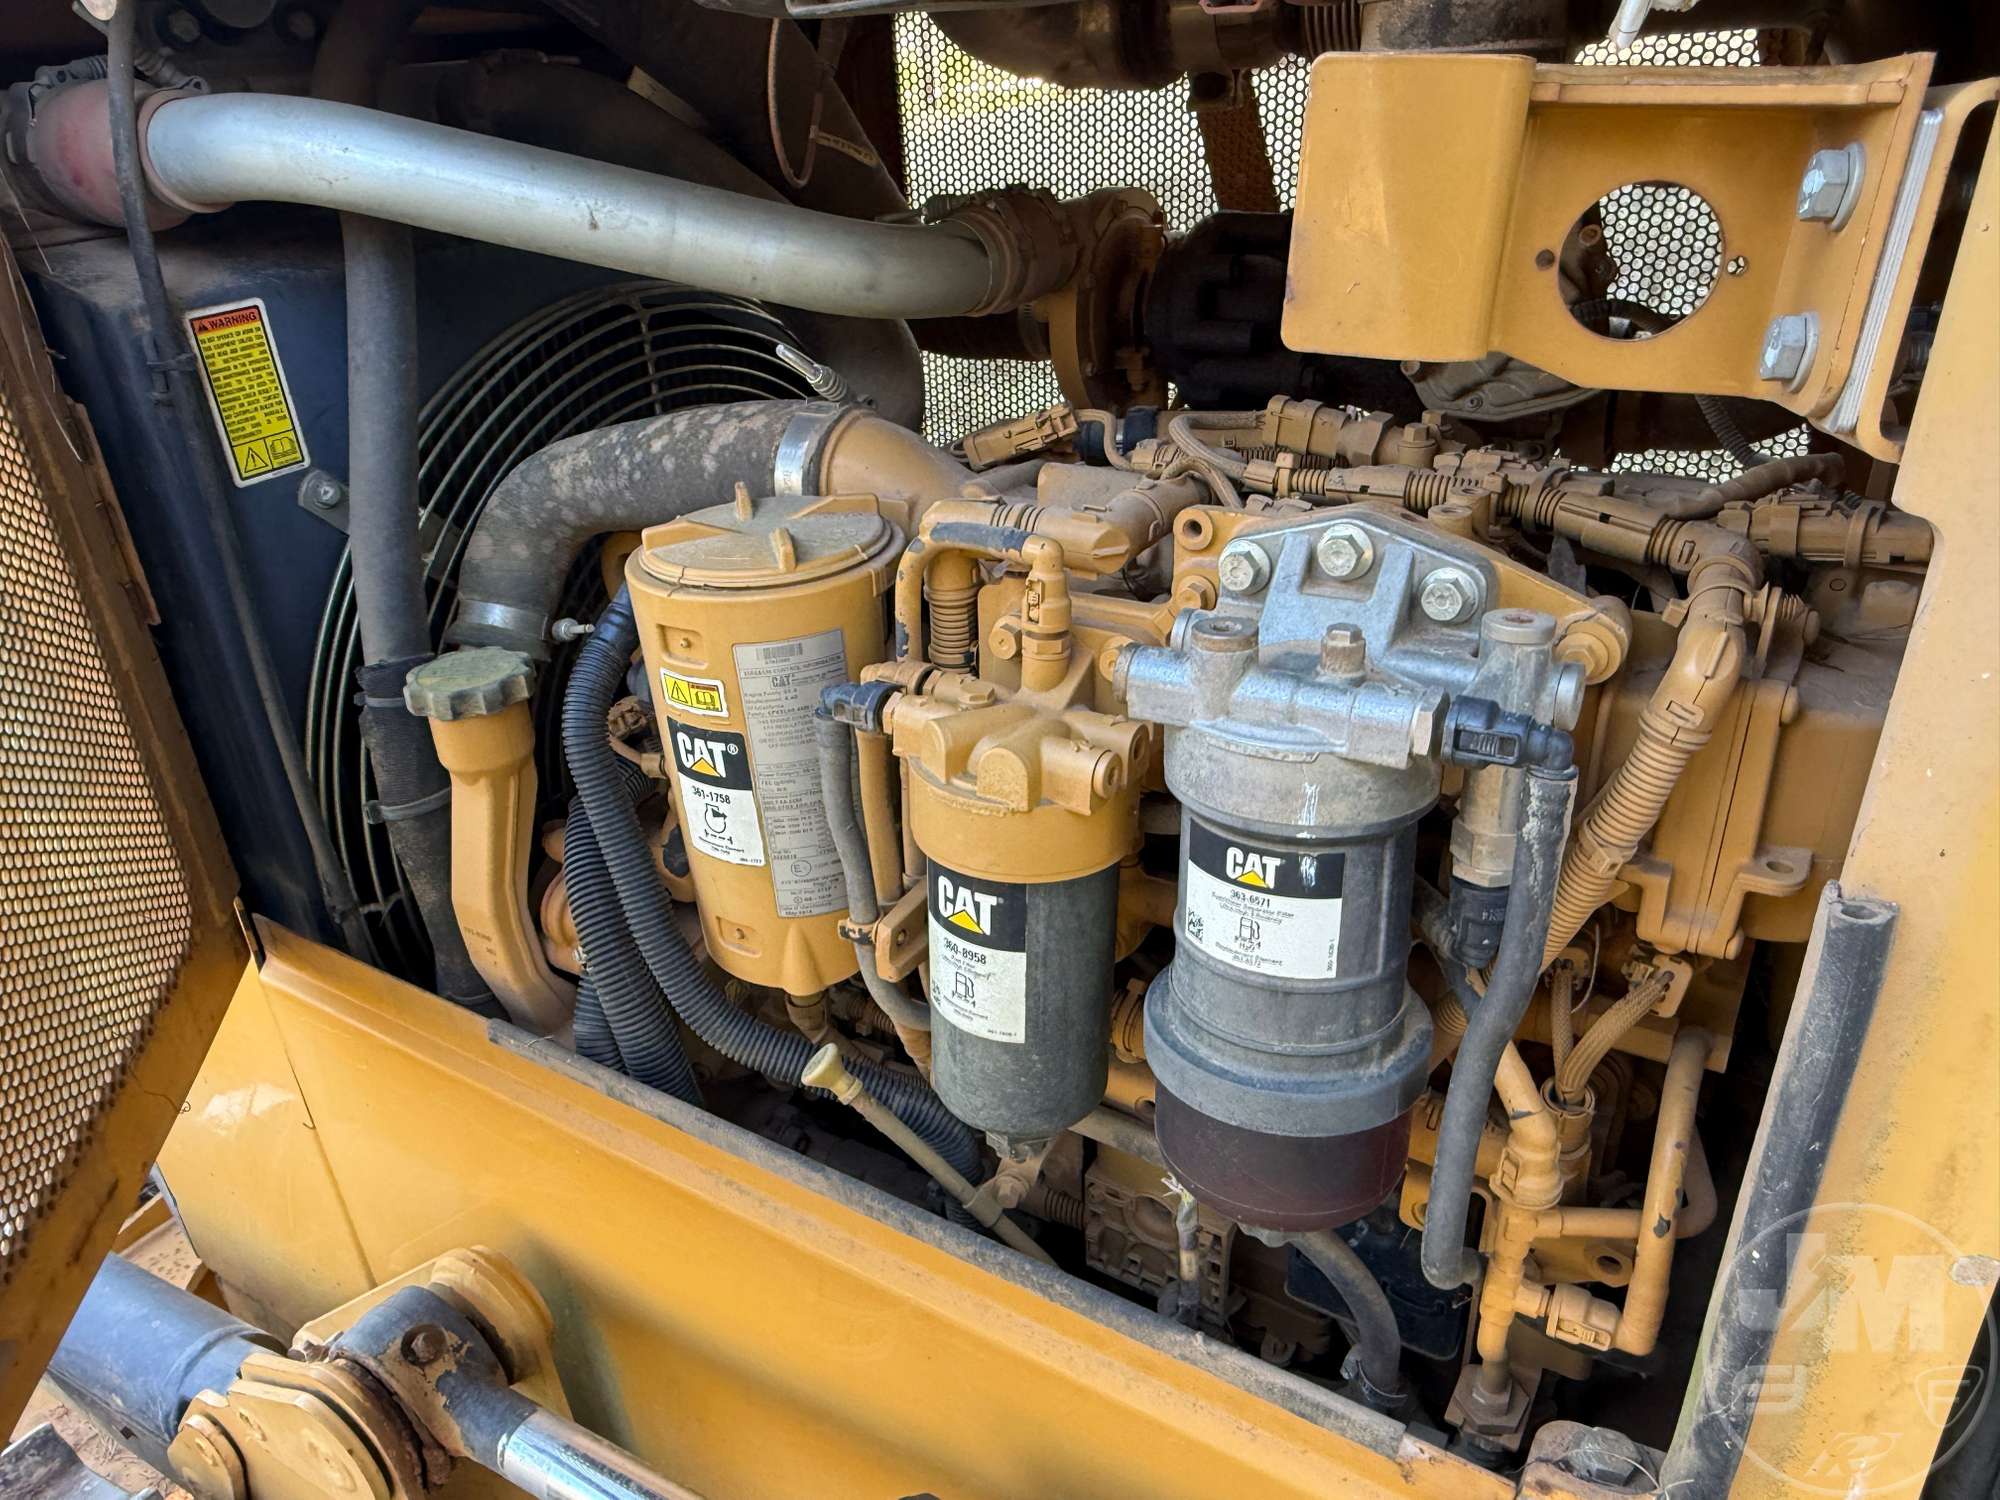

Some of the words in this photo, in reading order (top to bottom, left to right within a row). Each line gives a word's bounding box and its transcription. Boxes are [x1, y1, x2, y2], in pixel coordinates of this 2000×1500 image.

[209, 312, 257, 330] WARNING
[772, 673, 792, 688] CAT
[692, 785, 731, 804] 361-1758
